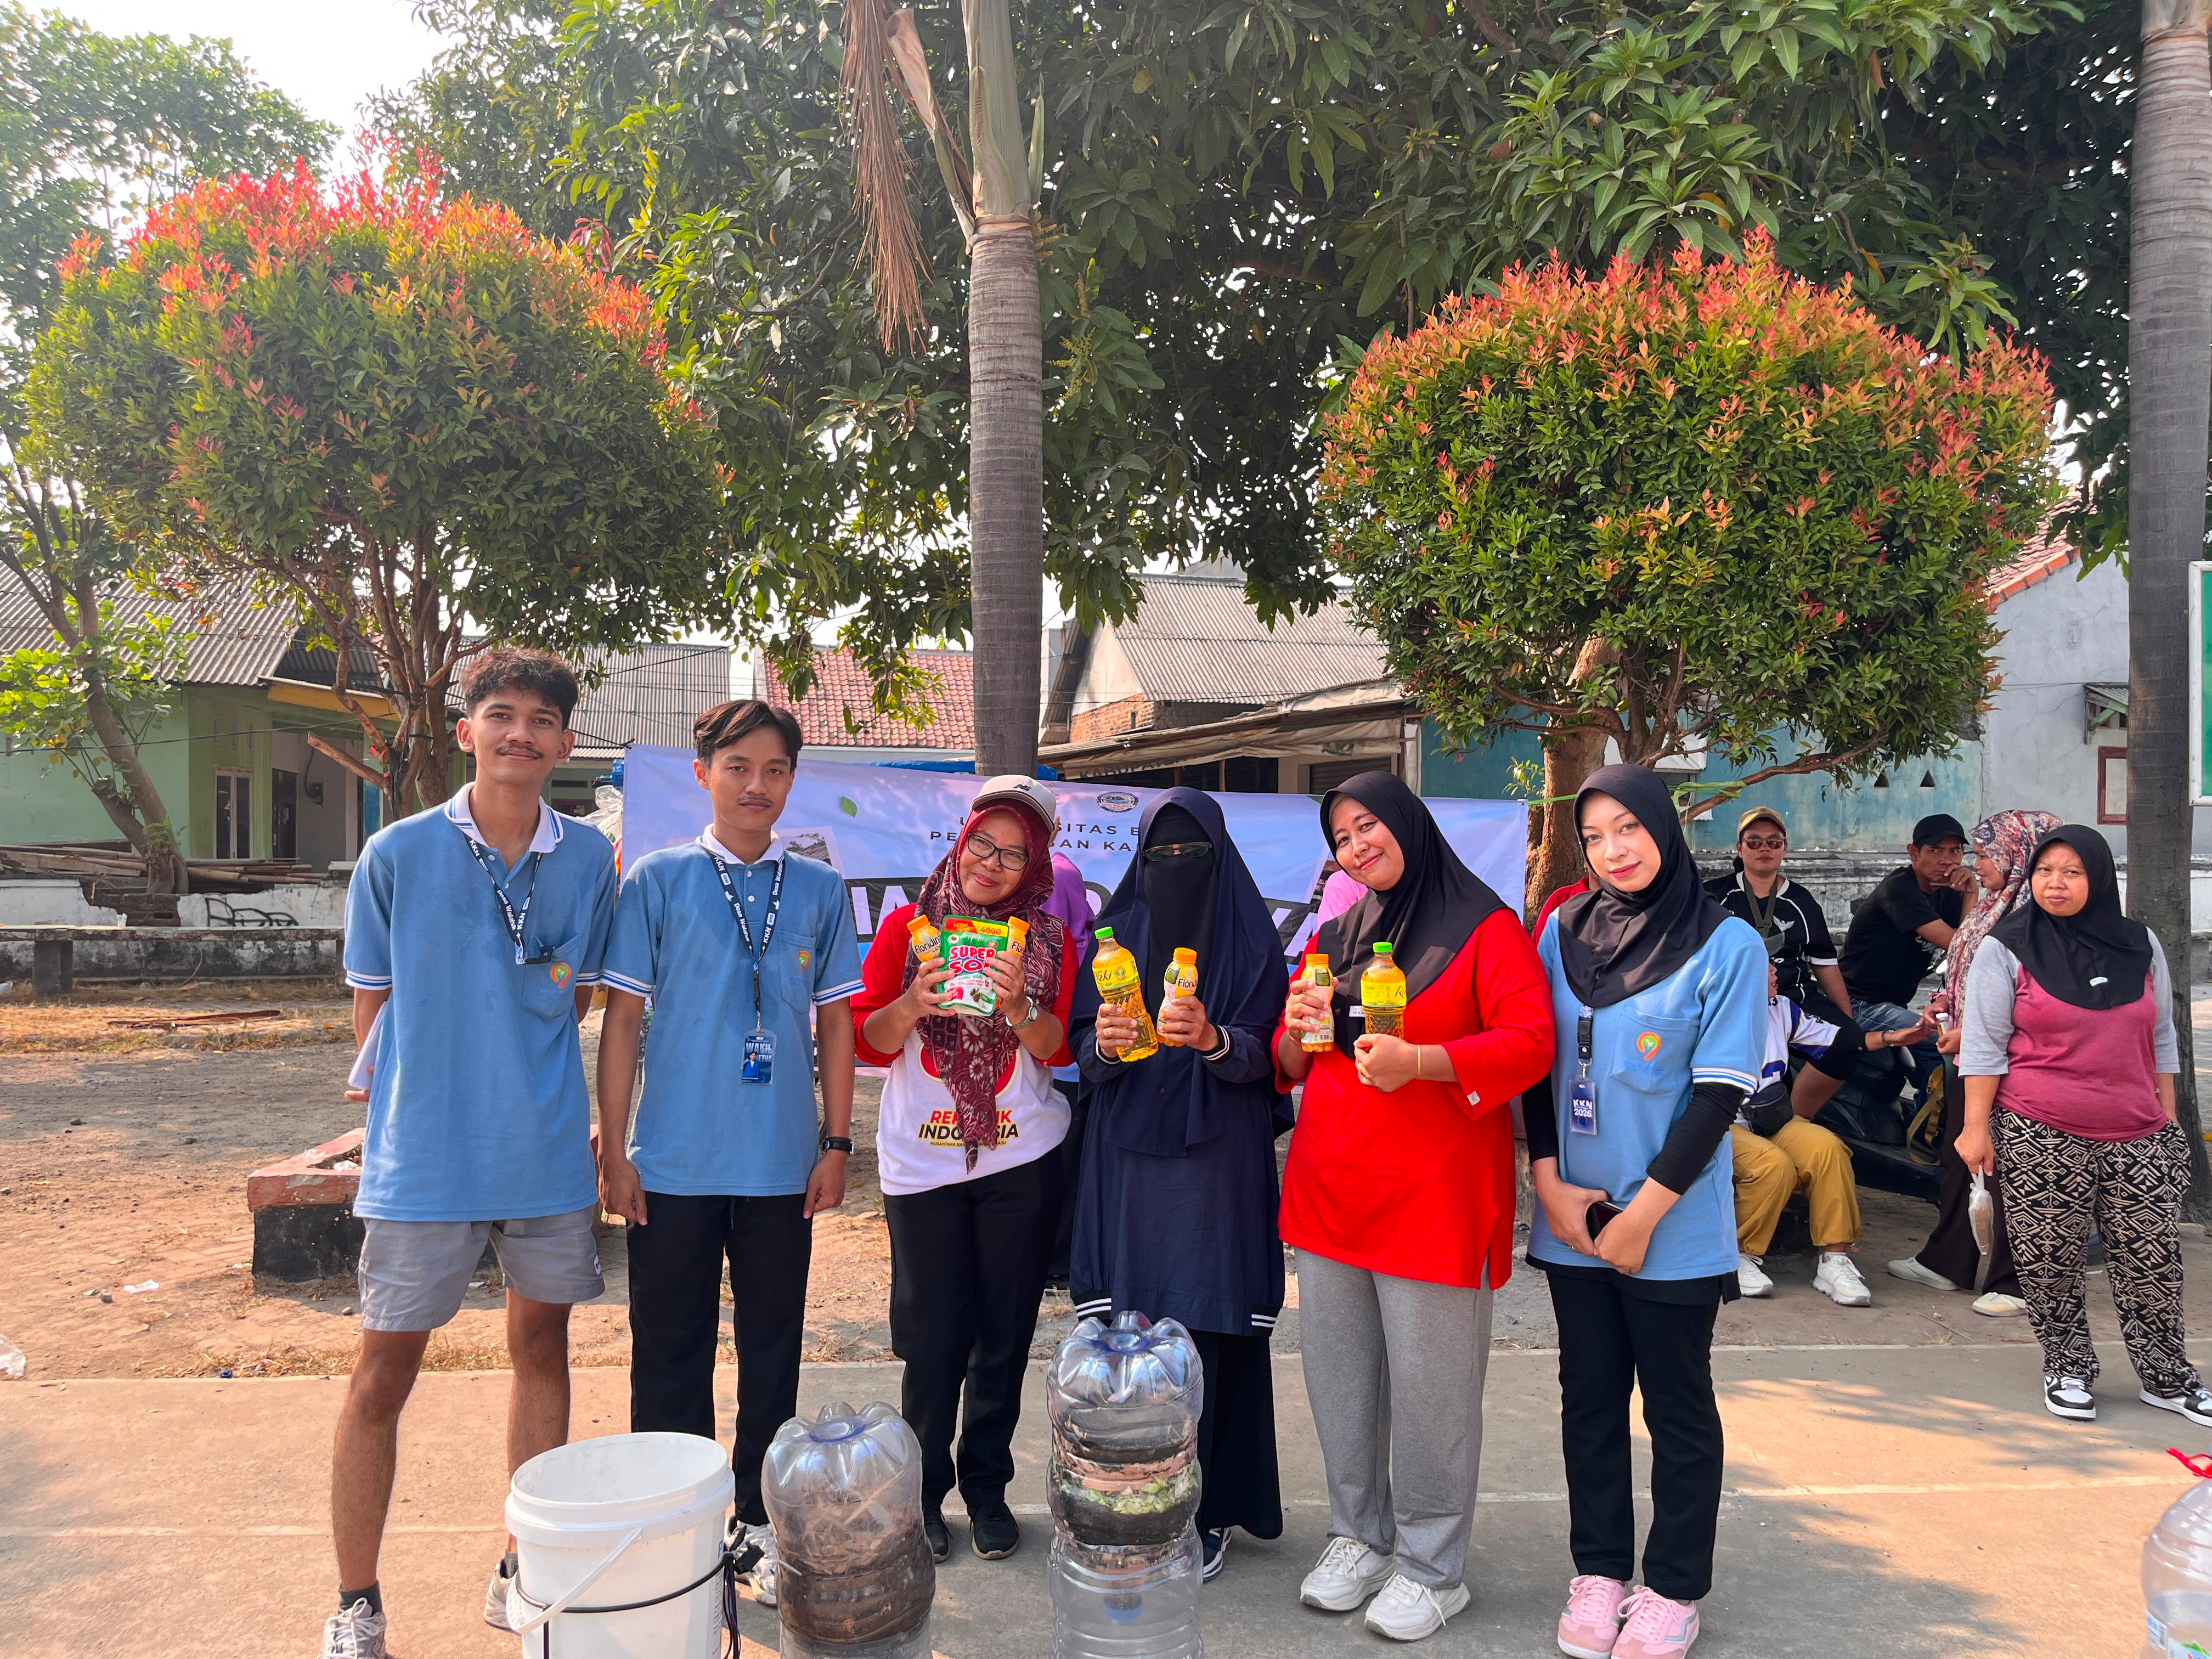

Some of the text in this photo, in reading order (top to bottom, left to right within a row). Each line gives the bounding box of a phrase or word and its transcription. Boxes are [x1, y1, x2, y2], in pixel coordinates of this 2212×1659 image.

[469, 839, 480, 857] KKN
[497, 890, 509, 904] Desa
[714, 857, 725, 871] KKN
[734, 902, 743, 917] Desa
[517, 912, 526, 930] KKN
[763, 927, 772, 944] KKN
[980, 926, 1001, 935] 4000
[915, 935, 941, 953] Floridin
[950, 946, 996, 960] SUPER
[1573, 1099, 1593, 1110] KKN
[1573, 1108, 1593, 1118] 2026
